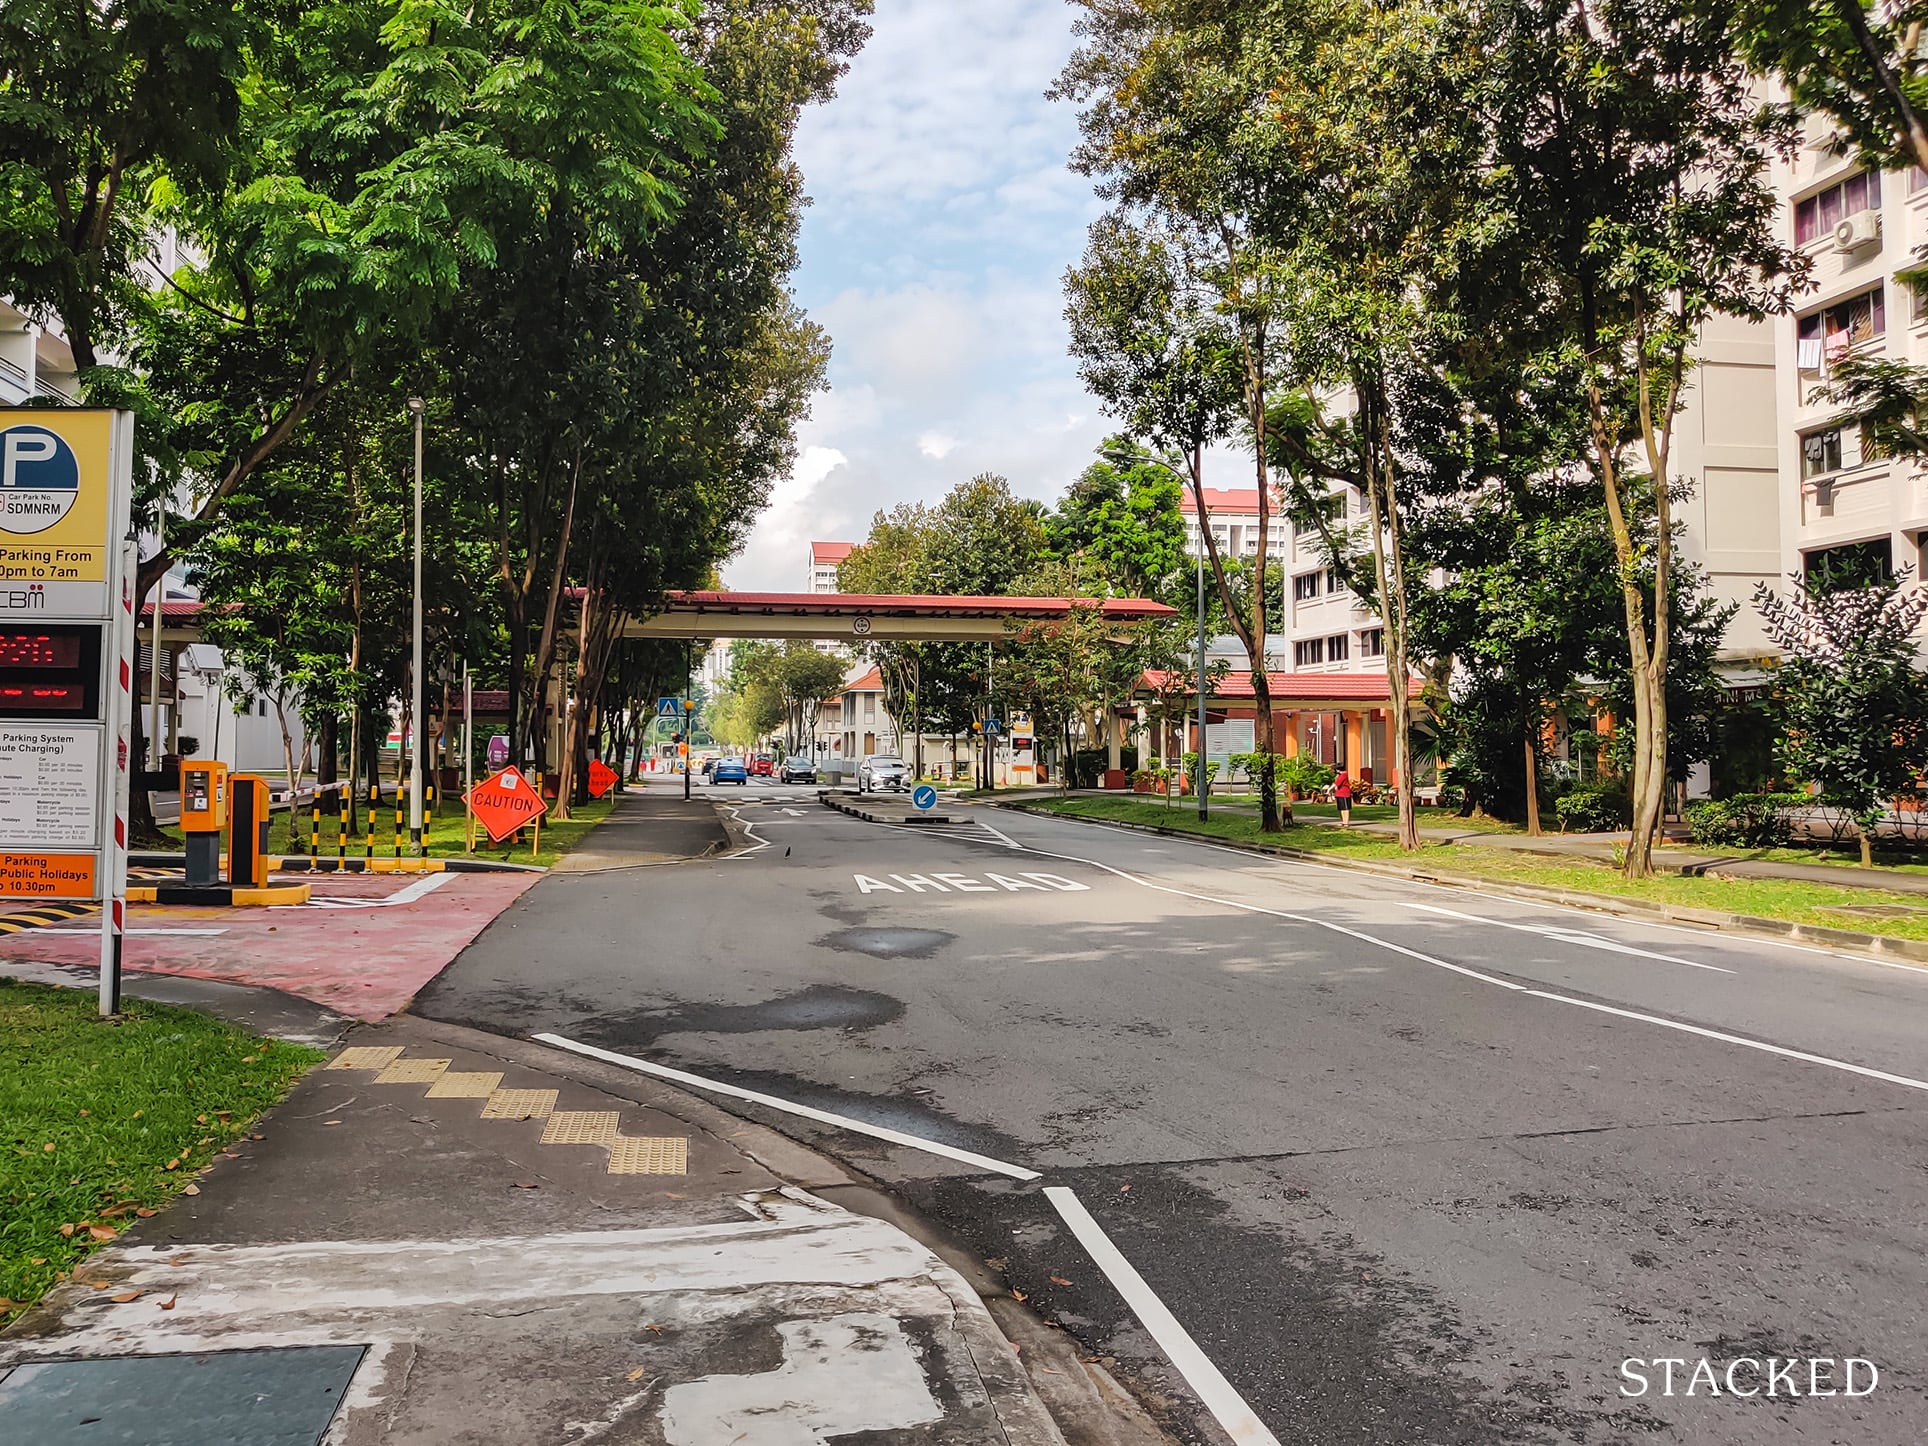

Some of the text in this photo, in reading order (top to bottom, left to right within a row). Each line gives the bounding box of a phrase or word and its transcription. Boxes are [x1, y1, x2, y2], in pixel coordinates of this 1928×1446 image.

[4, 433, 57, 486] P
[7, 503, 61, 514] SDMNRM
[0, 549, 92, 564] Parking From
[31, 566, 45, 577] to
[50, 566, 78, 577] 7am
[3, 734, 74, 744] Parking System
[0, 744, 64, 754] ute Charging)
[474, 793, 534, 812] CAUTION
[5, 856, 47, 868] Parking
[0, 869, 88, 881] Public Holidays
[10, 881, 56, 893] 10.30pm
[853, 873, 1092, 894] AHEAD
